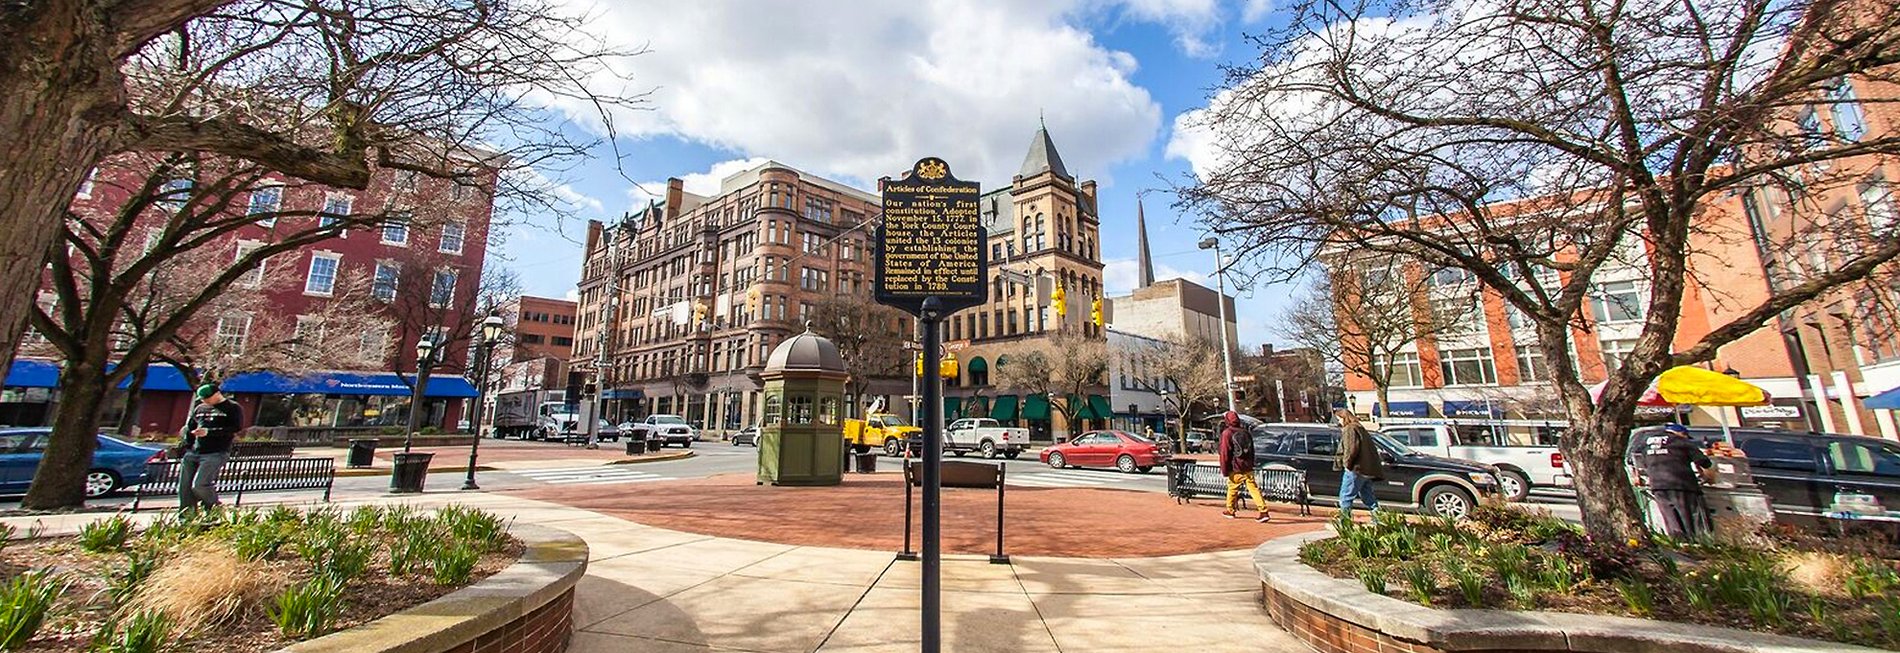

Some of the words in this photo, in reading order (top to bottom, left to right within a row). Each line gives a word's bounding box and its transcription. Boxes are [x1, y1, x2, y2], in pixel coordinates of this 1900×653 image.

[926, 185, 977, 193] Confederation
[942, 208, 977, 216] Adopted
[922, 222, 950, 231] County
